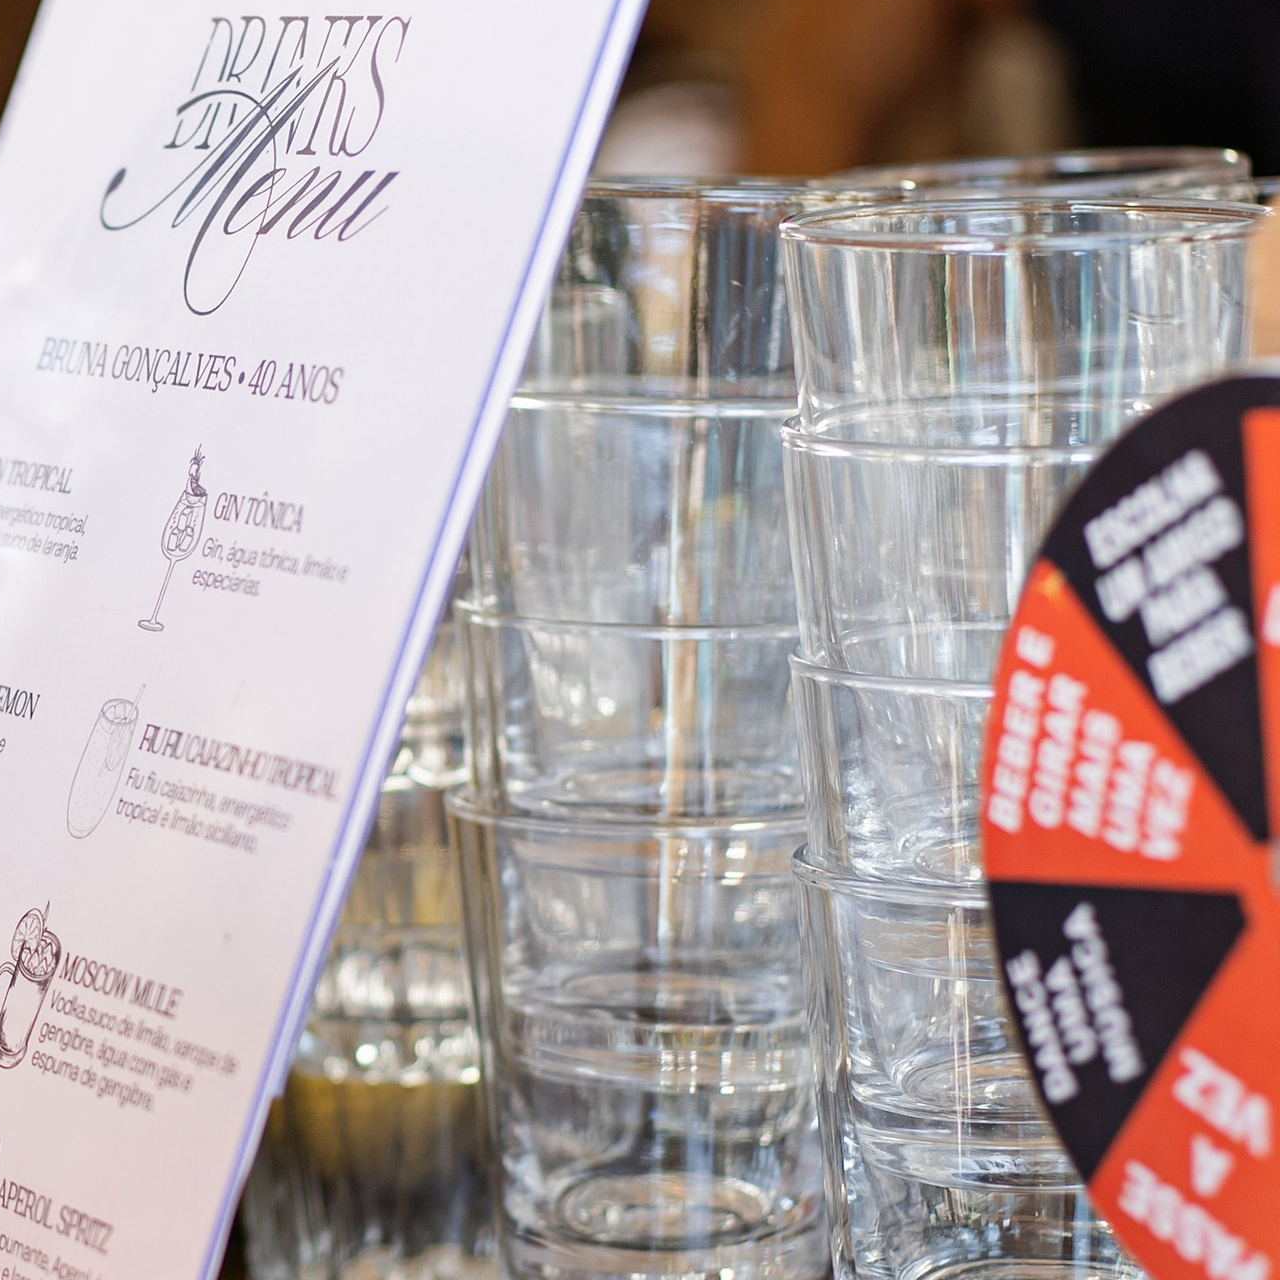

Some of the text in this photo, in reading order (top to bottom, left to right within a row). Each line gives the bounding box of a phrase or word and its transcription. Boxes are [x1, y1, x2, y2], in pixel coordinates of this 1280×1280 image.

[163, 15, 412, 157] DRINKS
[100, 55, 401, 316] Menu
[36, 336, 345, 405] BRUNA GONÇALVES 40 ANOS
[6, 460, 73, 495] TROPICAL
[44, 513, 89, 537] tropical,
[213, 491, 305, 534] GIN TÔNICA
[0, 533, 27, 550] suco
[26, 533, 42, 553] de
[41, 536, 79, 564] laranja.
[201, 537, 224, 564] Gin,
[225, 540, 258, 569] água
[257, 548, 301, 576] tônica,
[336, 565, 352, 583] e
[138, 723, 167, 754] FIU
[161, 728, 188, 760] FIU
[265, 752, 340, 800] TROPICAL
[987, 624, 1056, 835] BEBER E
[1027, 671, 1089, 831] GIRAR
[124, 767, 146, 791] Fiu
[142, 770, 160, 795] fiu
[1065, 706, 1123, 840] MAIS
[1101, 738, 1157, 854] UMA
[116, 798, 162, 825] tropical
[158, 811, 169, 827] e
[169, 810, 203, 837] limão
[1138, 755, 1198, 862] VEZ
[59, 952, 185, 1022] MOSCOW MULE
[1043, 954, 1099, 1066] UMA
[38, 1021, 95, 1057] gengibre,
[94, 1037, 129, 1068] água
[128, 1052, 158, 1076] com
[117, 1016, 137, 1037] de
[1006, 948, 1081, 1106] DANCE
[31, 1049, 80, 1083] espuma
[78, 1063, 99, 1088] de
[1172, 1045, 1272, 1160] VEZ
[1188, 1132, 1235, 1199] A
[55, 1204, 115, 1257] SPRITZ
